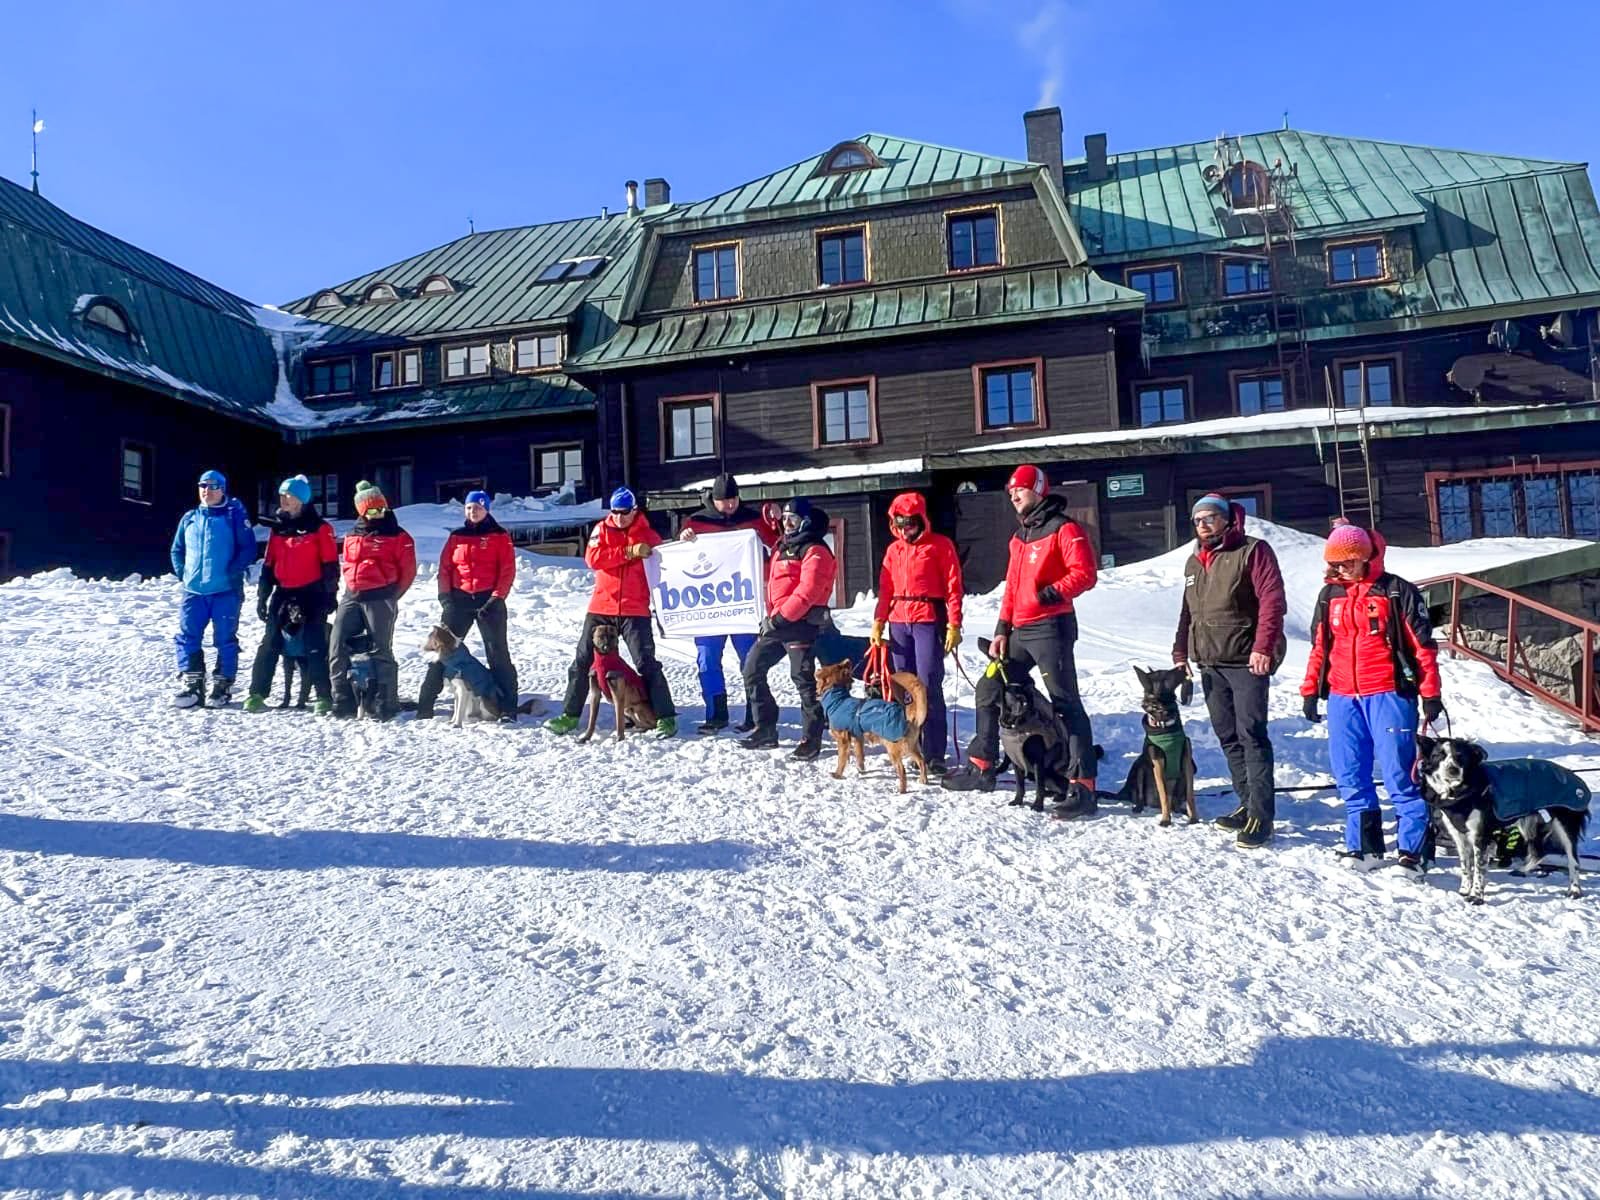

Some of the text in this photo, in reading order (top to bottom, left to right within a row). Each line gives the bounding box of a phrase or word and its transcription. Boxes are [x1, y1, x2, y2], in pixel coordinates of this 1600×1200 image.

[658, 571, 755, 610] bosch
[663, 606, 755, 624] PETFOOD CONCEPTS
